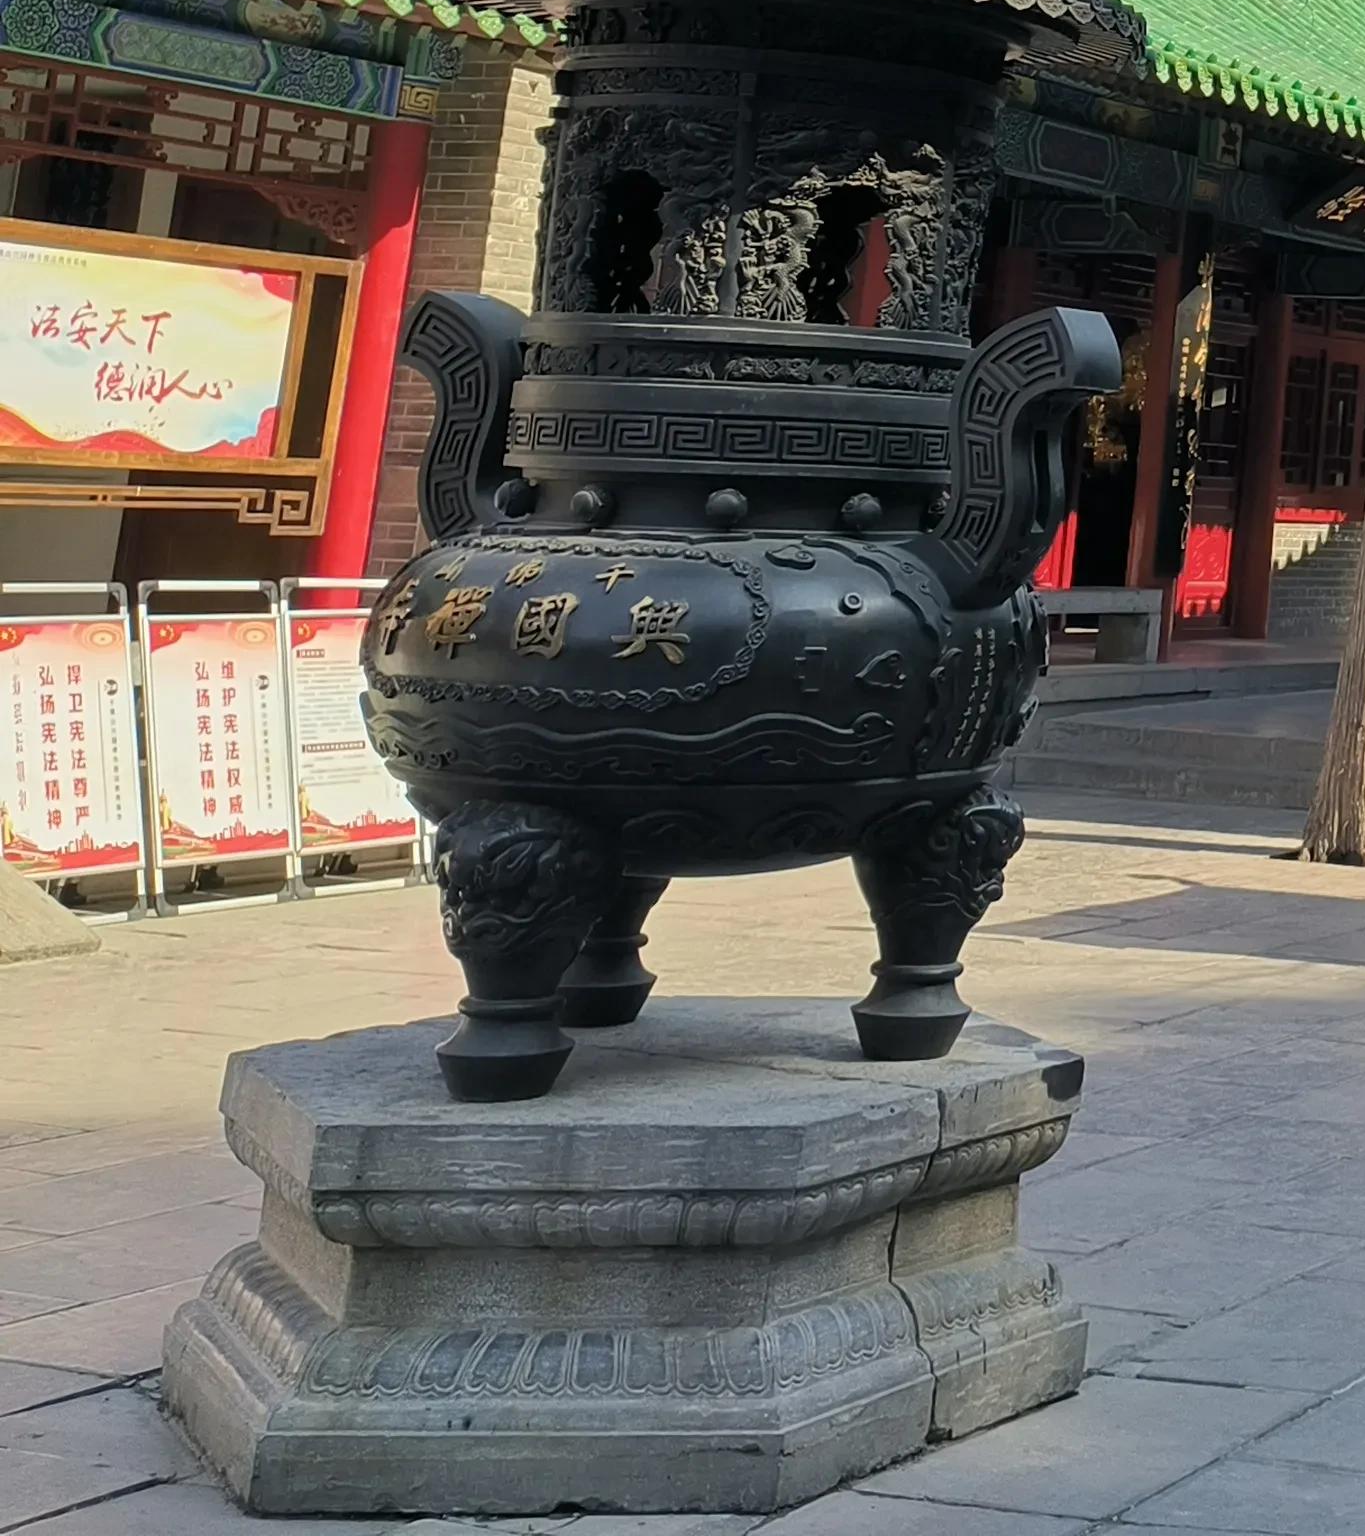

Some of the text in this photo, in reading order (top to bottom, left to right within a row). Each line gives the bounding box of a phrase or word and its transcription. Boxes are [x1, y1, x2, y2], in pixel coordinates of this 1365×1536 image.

[94, 361, 234, 404] 德润人心
[39, 665, 63, 830] 弘扬宪法精神
[67, 664, 91, 827] 捍卫宪法尊严
[194, 661, 217, 817] 弘扬宪法精神
[221, 660, 244, 815] 维护宪法权威
